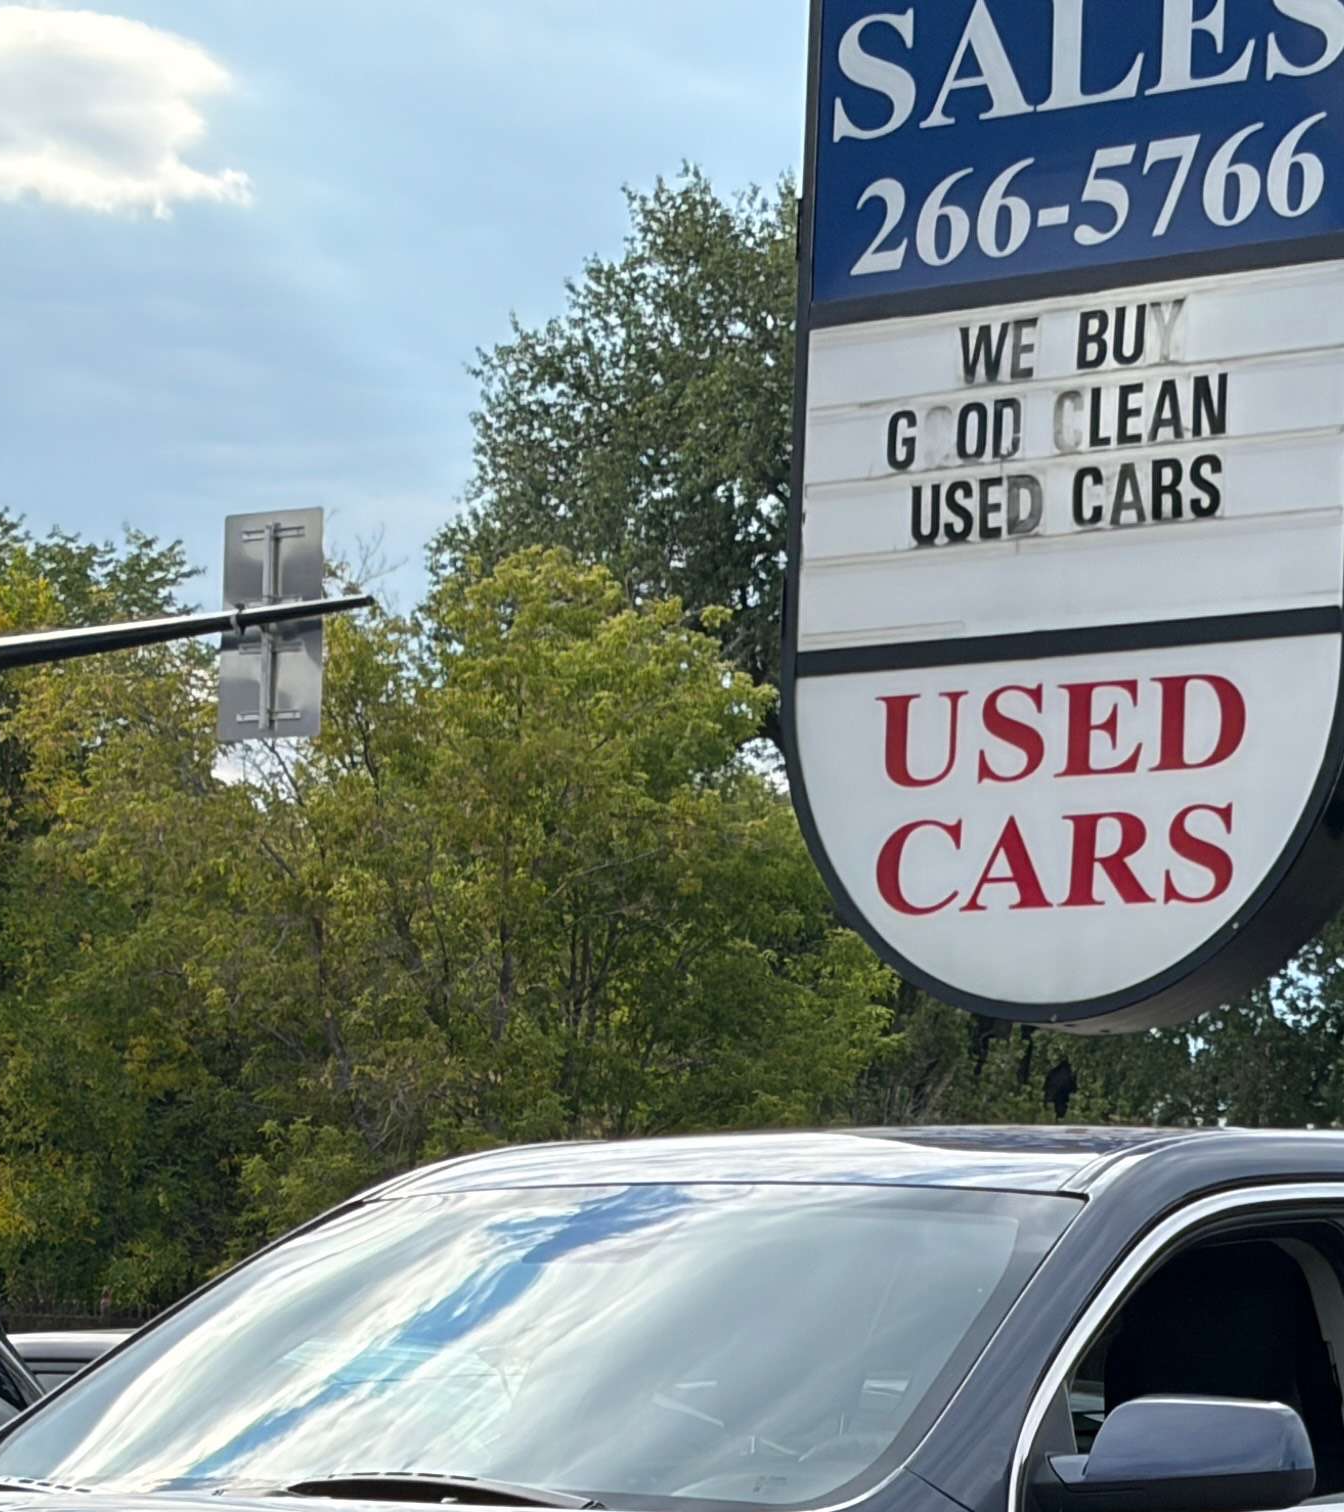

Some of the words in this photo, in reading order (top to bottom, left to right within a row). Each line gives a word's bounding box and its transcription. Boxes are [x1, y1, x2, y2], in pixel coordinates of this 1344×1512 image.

[850, 111, 1327, 276] 266-5766
[959, 317, 1038, 384] WE
[1076, 298, 1185, 370] BUY
[887, 397, 1021, 471] GOD
[1054, 373, 1228, 454] CLEAN
[911, 474, 1043, 545] USED
[1073, 454, 1222, 526] CARS
[875, 674, 1246, 788] USED
[876, 802, 1234, 915] CARS
